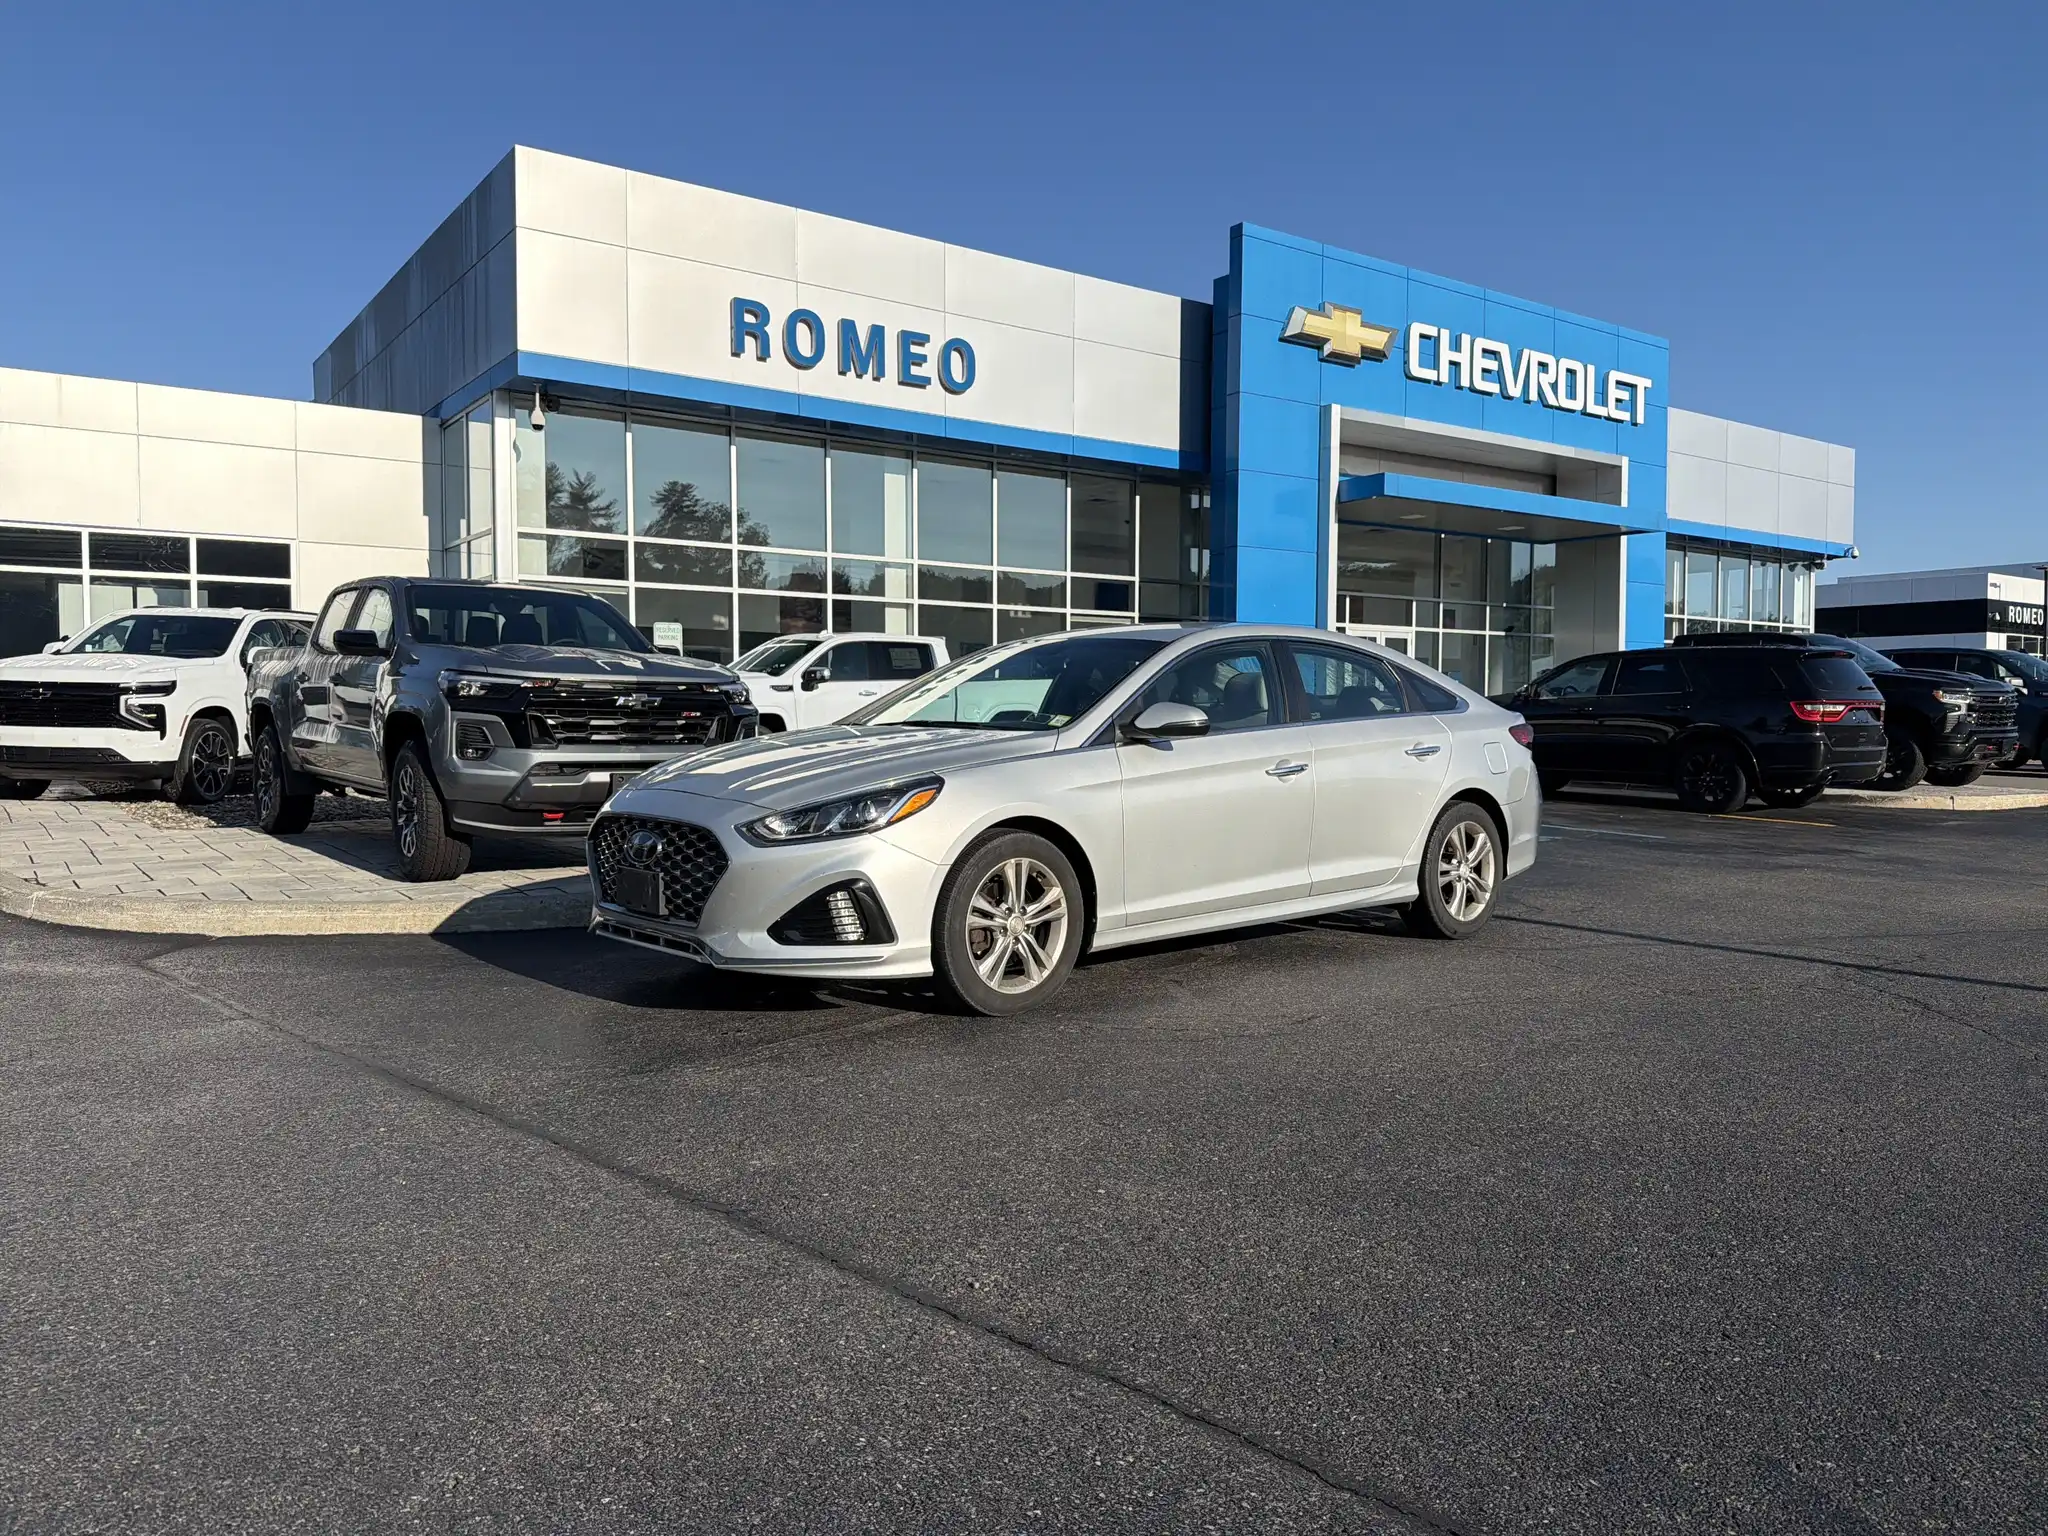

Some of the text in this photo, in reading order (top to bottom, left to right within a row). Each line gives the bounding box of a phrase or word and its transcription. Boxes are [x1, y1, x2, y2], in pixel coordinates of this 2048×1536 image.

[730, 297, 976, 396] ROMEO
[1405, 312, 1652, 426] CHEVROLET
[2008, 605, 2045, 626] ROMEO
